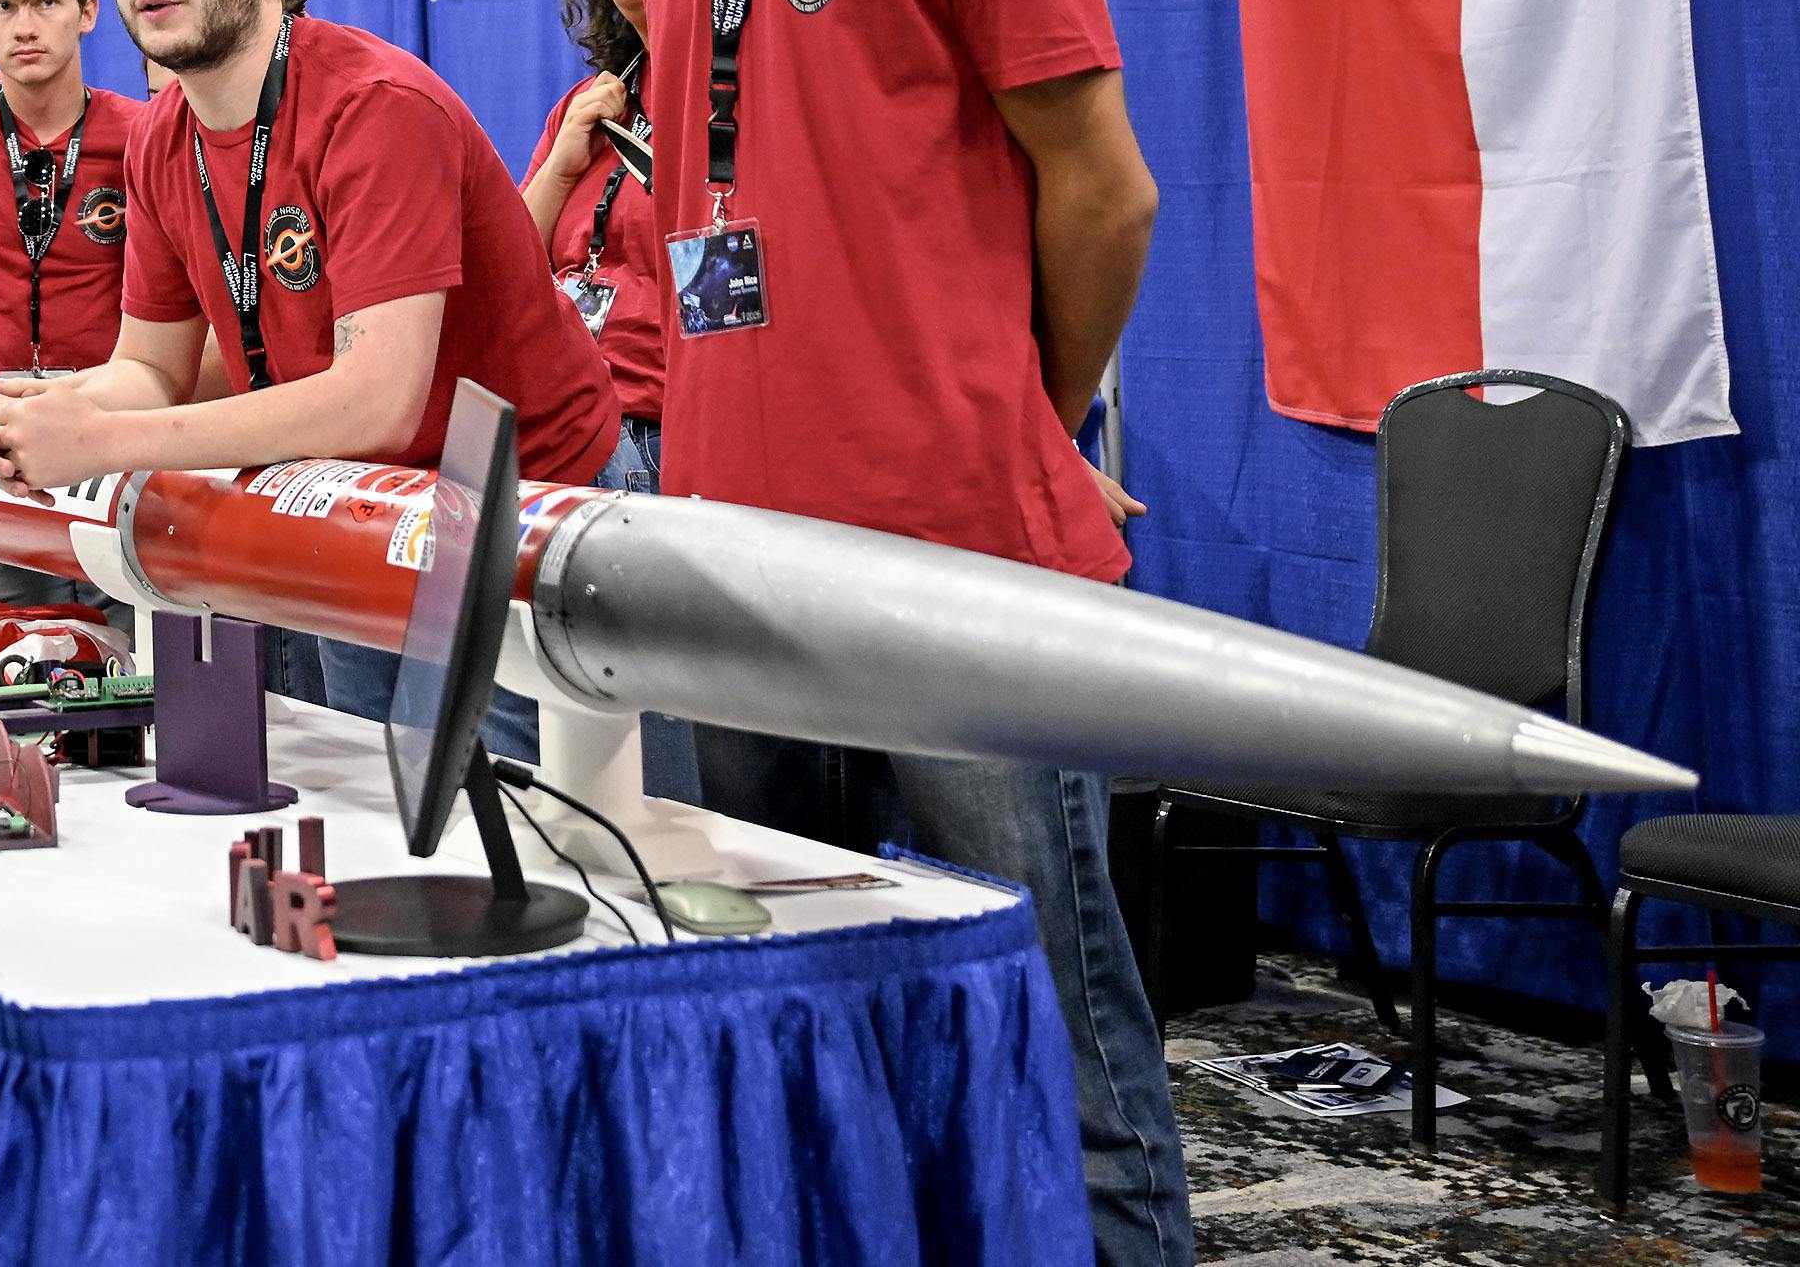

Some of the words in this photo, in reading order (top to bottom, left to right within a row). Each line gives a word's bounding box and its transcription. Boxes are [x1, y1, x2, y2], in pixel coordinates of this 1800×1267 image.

[275, 22, 286, 61] NORTHROP
[250, 139, 261, 186] NORTHROP
[257, 134, 268, 181] GRUMMAN
[222, 260, 240, 305] GRUMMAN
[226, 251, 241, 290] NORTHR
[243, 266, 251, 312] NORTHROP
